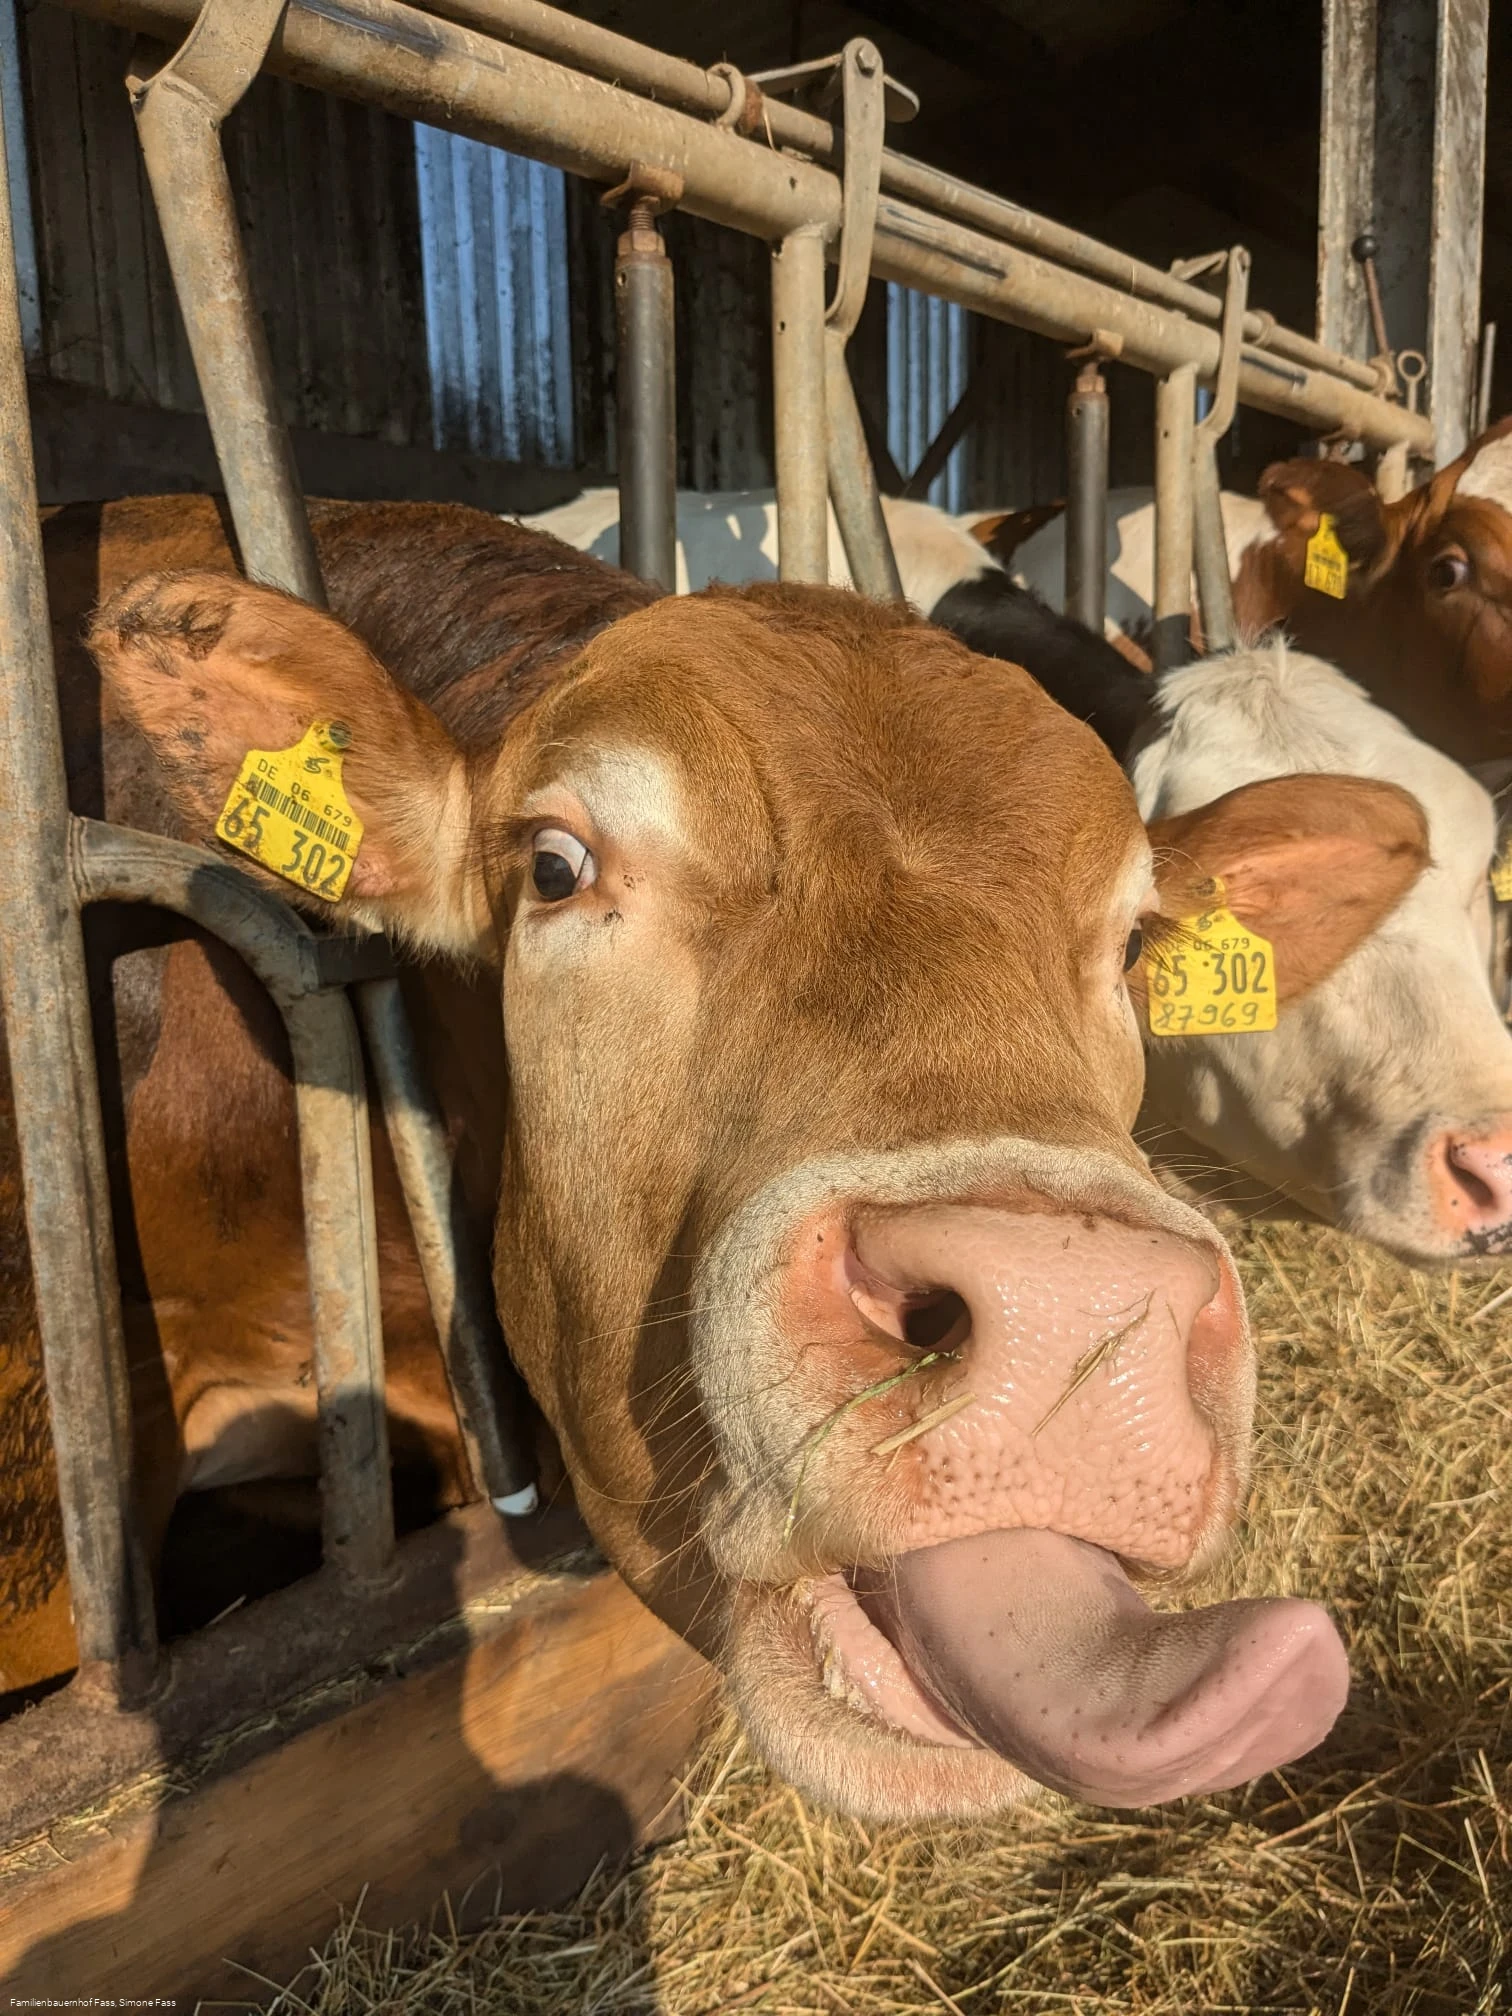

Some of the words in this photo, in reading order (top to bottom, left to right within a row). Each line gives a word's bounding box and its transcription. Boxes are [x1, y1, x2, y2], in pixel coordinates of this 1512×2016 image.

[257, 758, 279, 781] DE
[290, 782, 311, 801] 06
[323, 804, 353, 828] 679
[224, 798, 271, 849] 65
[281, 830, 346, 896] 302
[1221, 937, 1250, 950] 679
[1153, 955, 1188, 997] 65
[1210, 951, 1268, 996] 302
